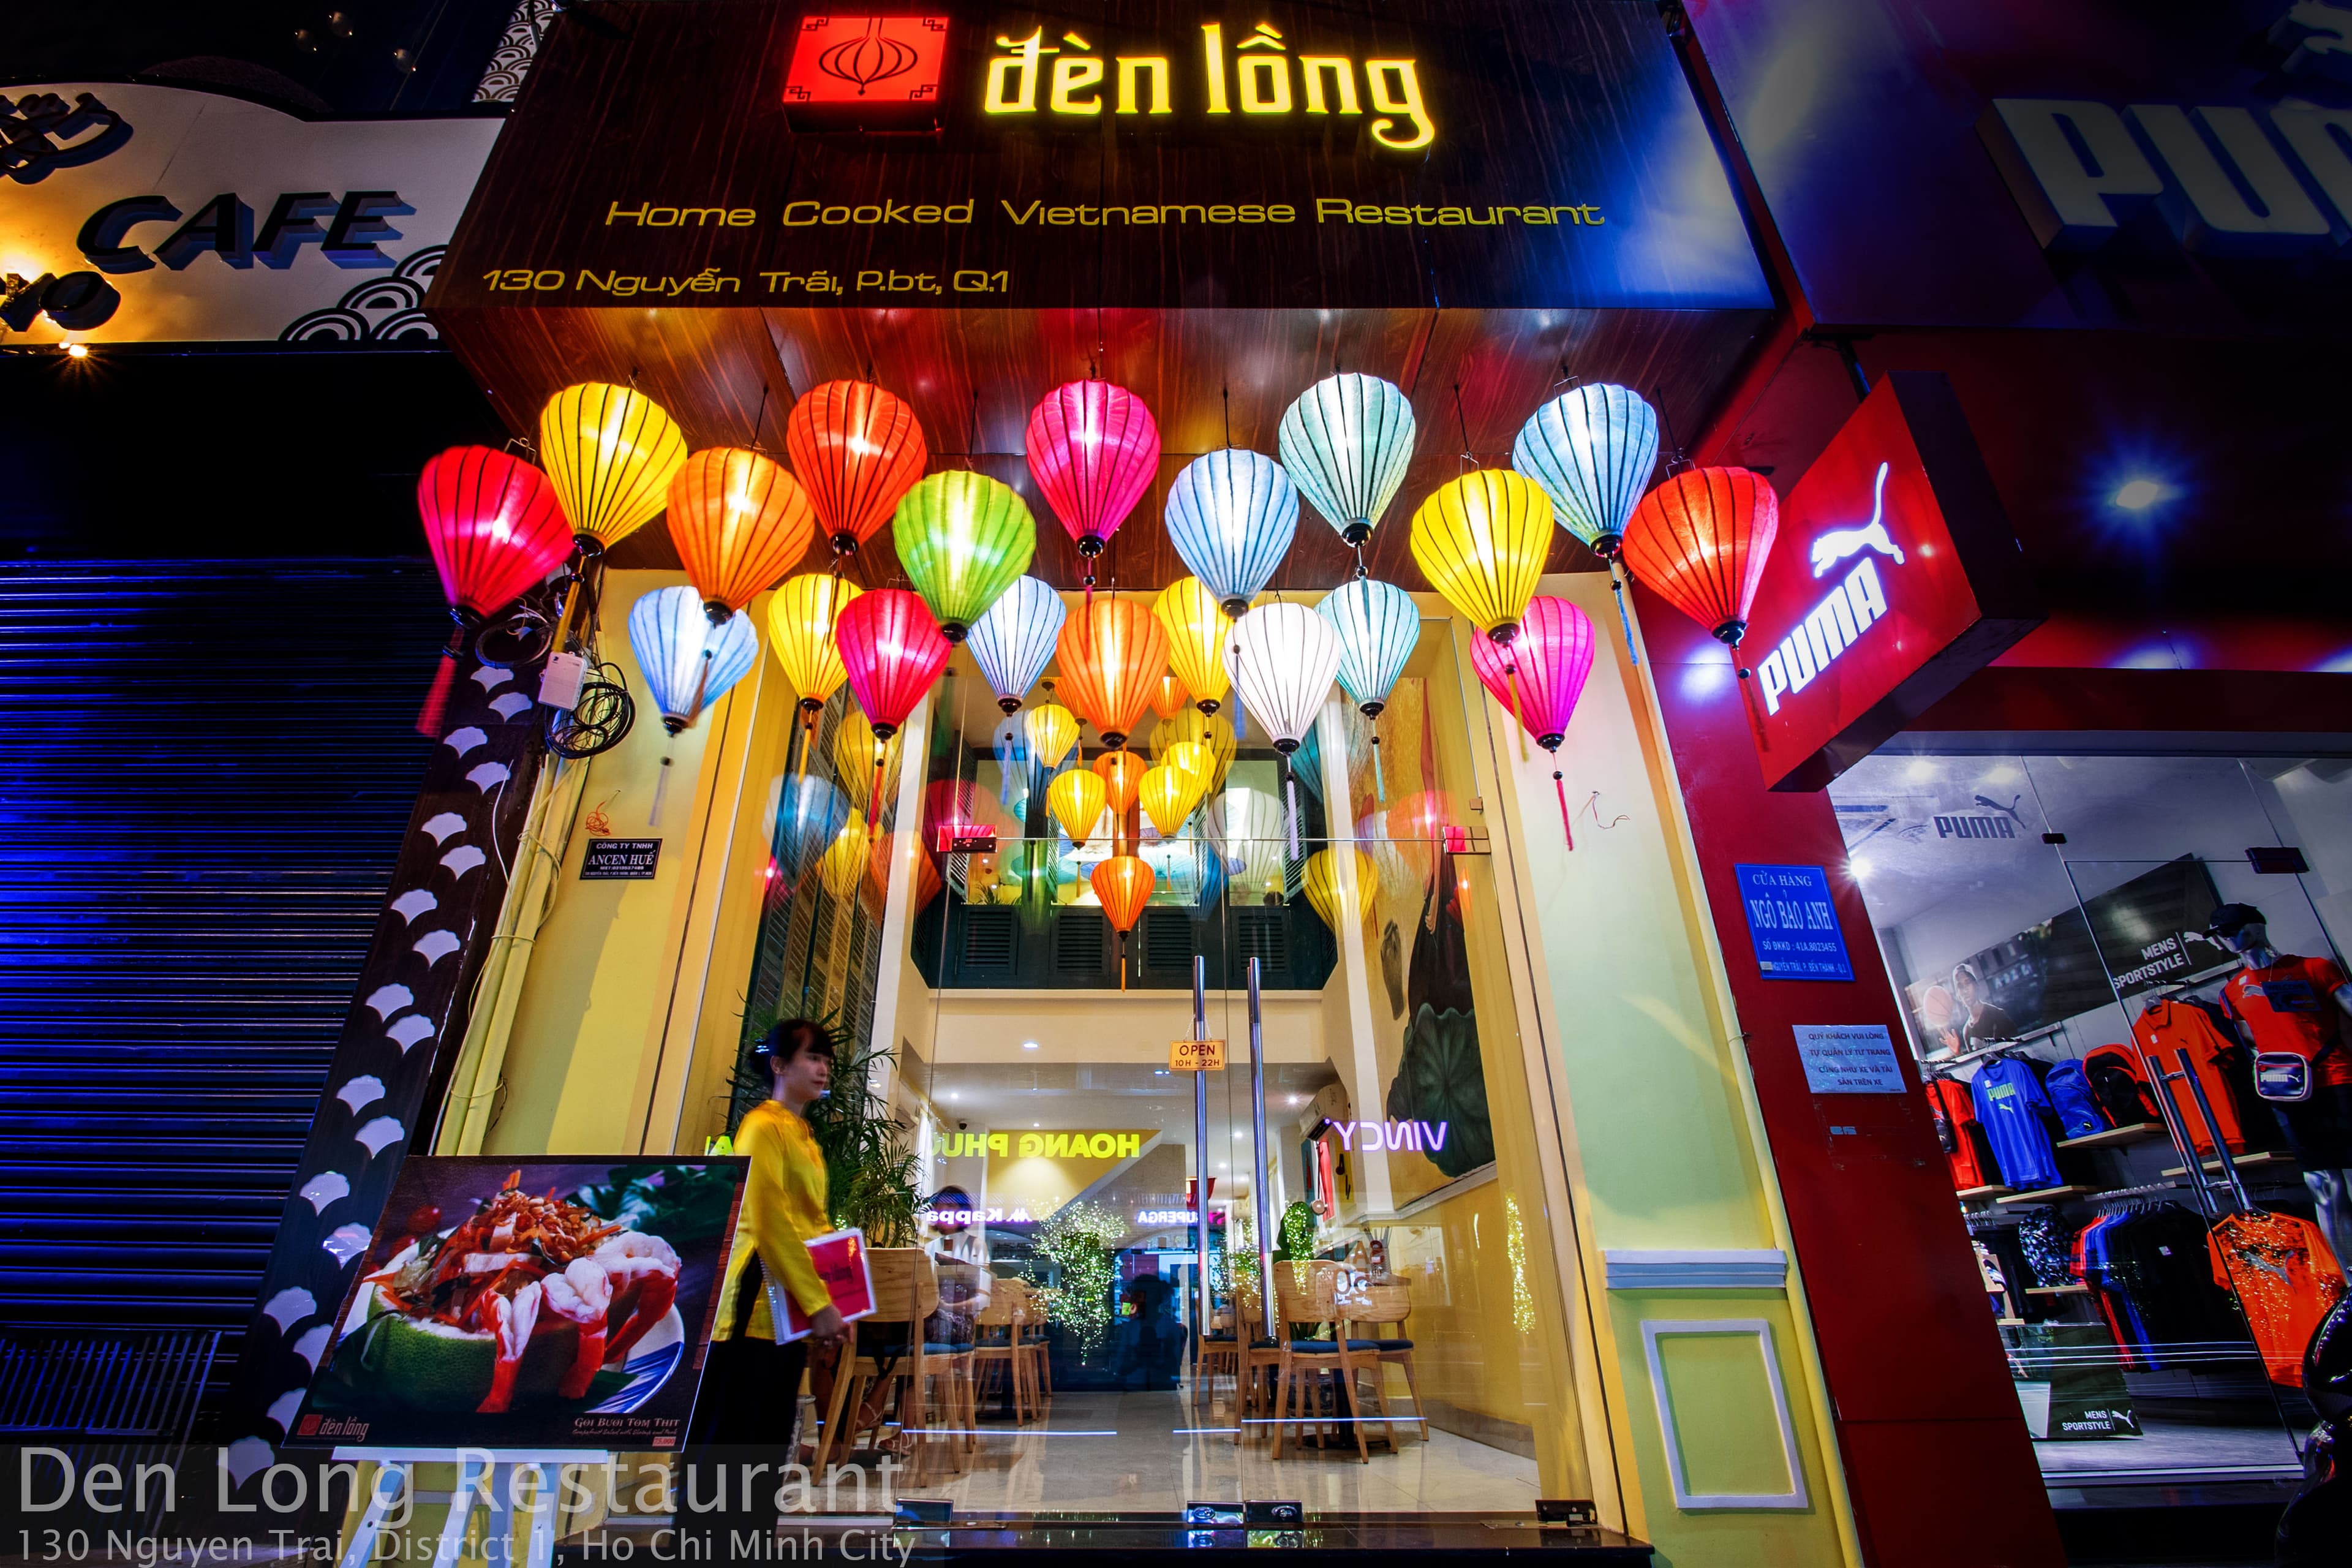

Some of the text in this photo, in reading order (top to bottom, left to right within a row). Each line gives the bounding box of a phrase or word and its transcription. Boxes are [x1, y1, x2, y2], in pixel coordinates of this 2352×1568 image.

[984, 22, 1437, 151] đèn lồng
[606, 198, 1605, 227] Home Cooked Vietnamese Restaurant
[77, 191, 412, 270] CAFE
[482, 269, 565, 292] 130
[576, 267, 741, 296] Nguyễn
[952, 270, 1010, 293] Q.1
[1757, 557, 1887, 715] PUMA
[1933, 815, 2015, 839] PUMA
[1753, 870, 1812, 886] CỬA HÀNG
[1750, 889, 1833, 930] NGÔ BẢO ANH
[2141, 937, 2177, 960] MENS
[2113, 953, 2185, 989] SPORTSTYLE
[1179, 1045, 1215, 1055] OPEN
[1986, 1082, 2016, 1101] PUMA
[2062, 1421, 2111, 1431] SPORTSTYLE
[2084, 1411, 2107, 1419] MENS
[318, 1416, 369, 1442] đèn lồng
